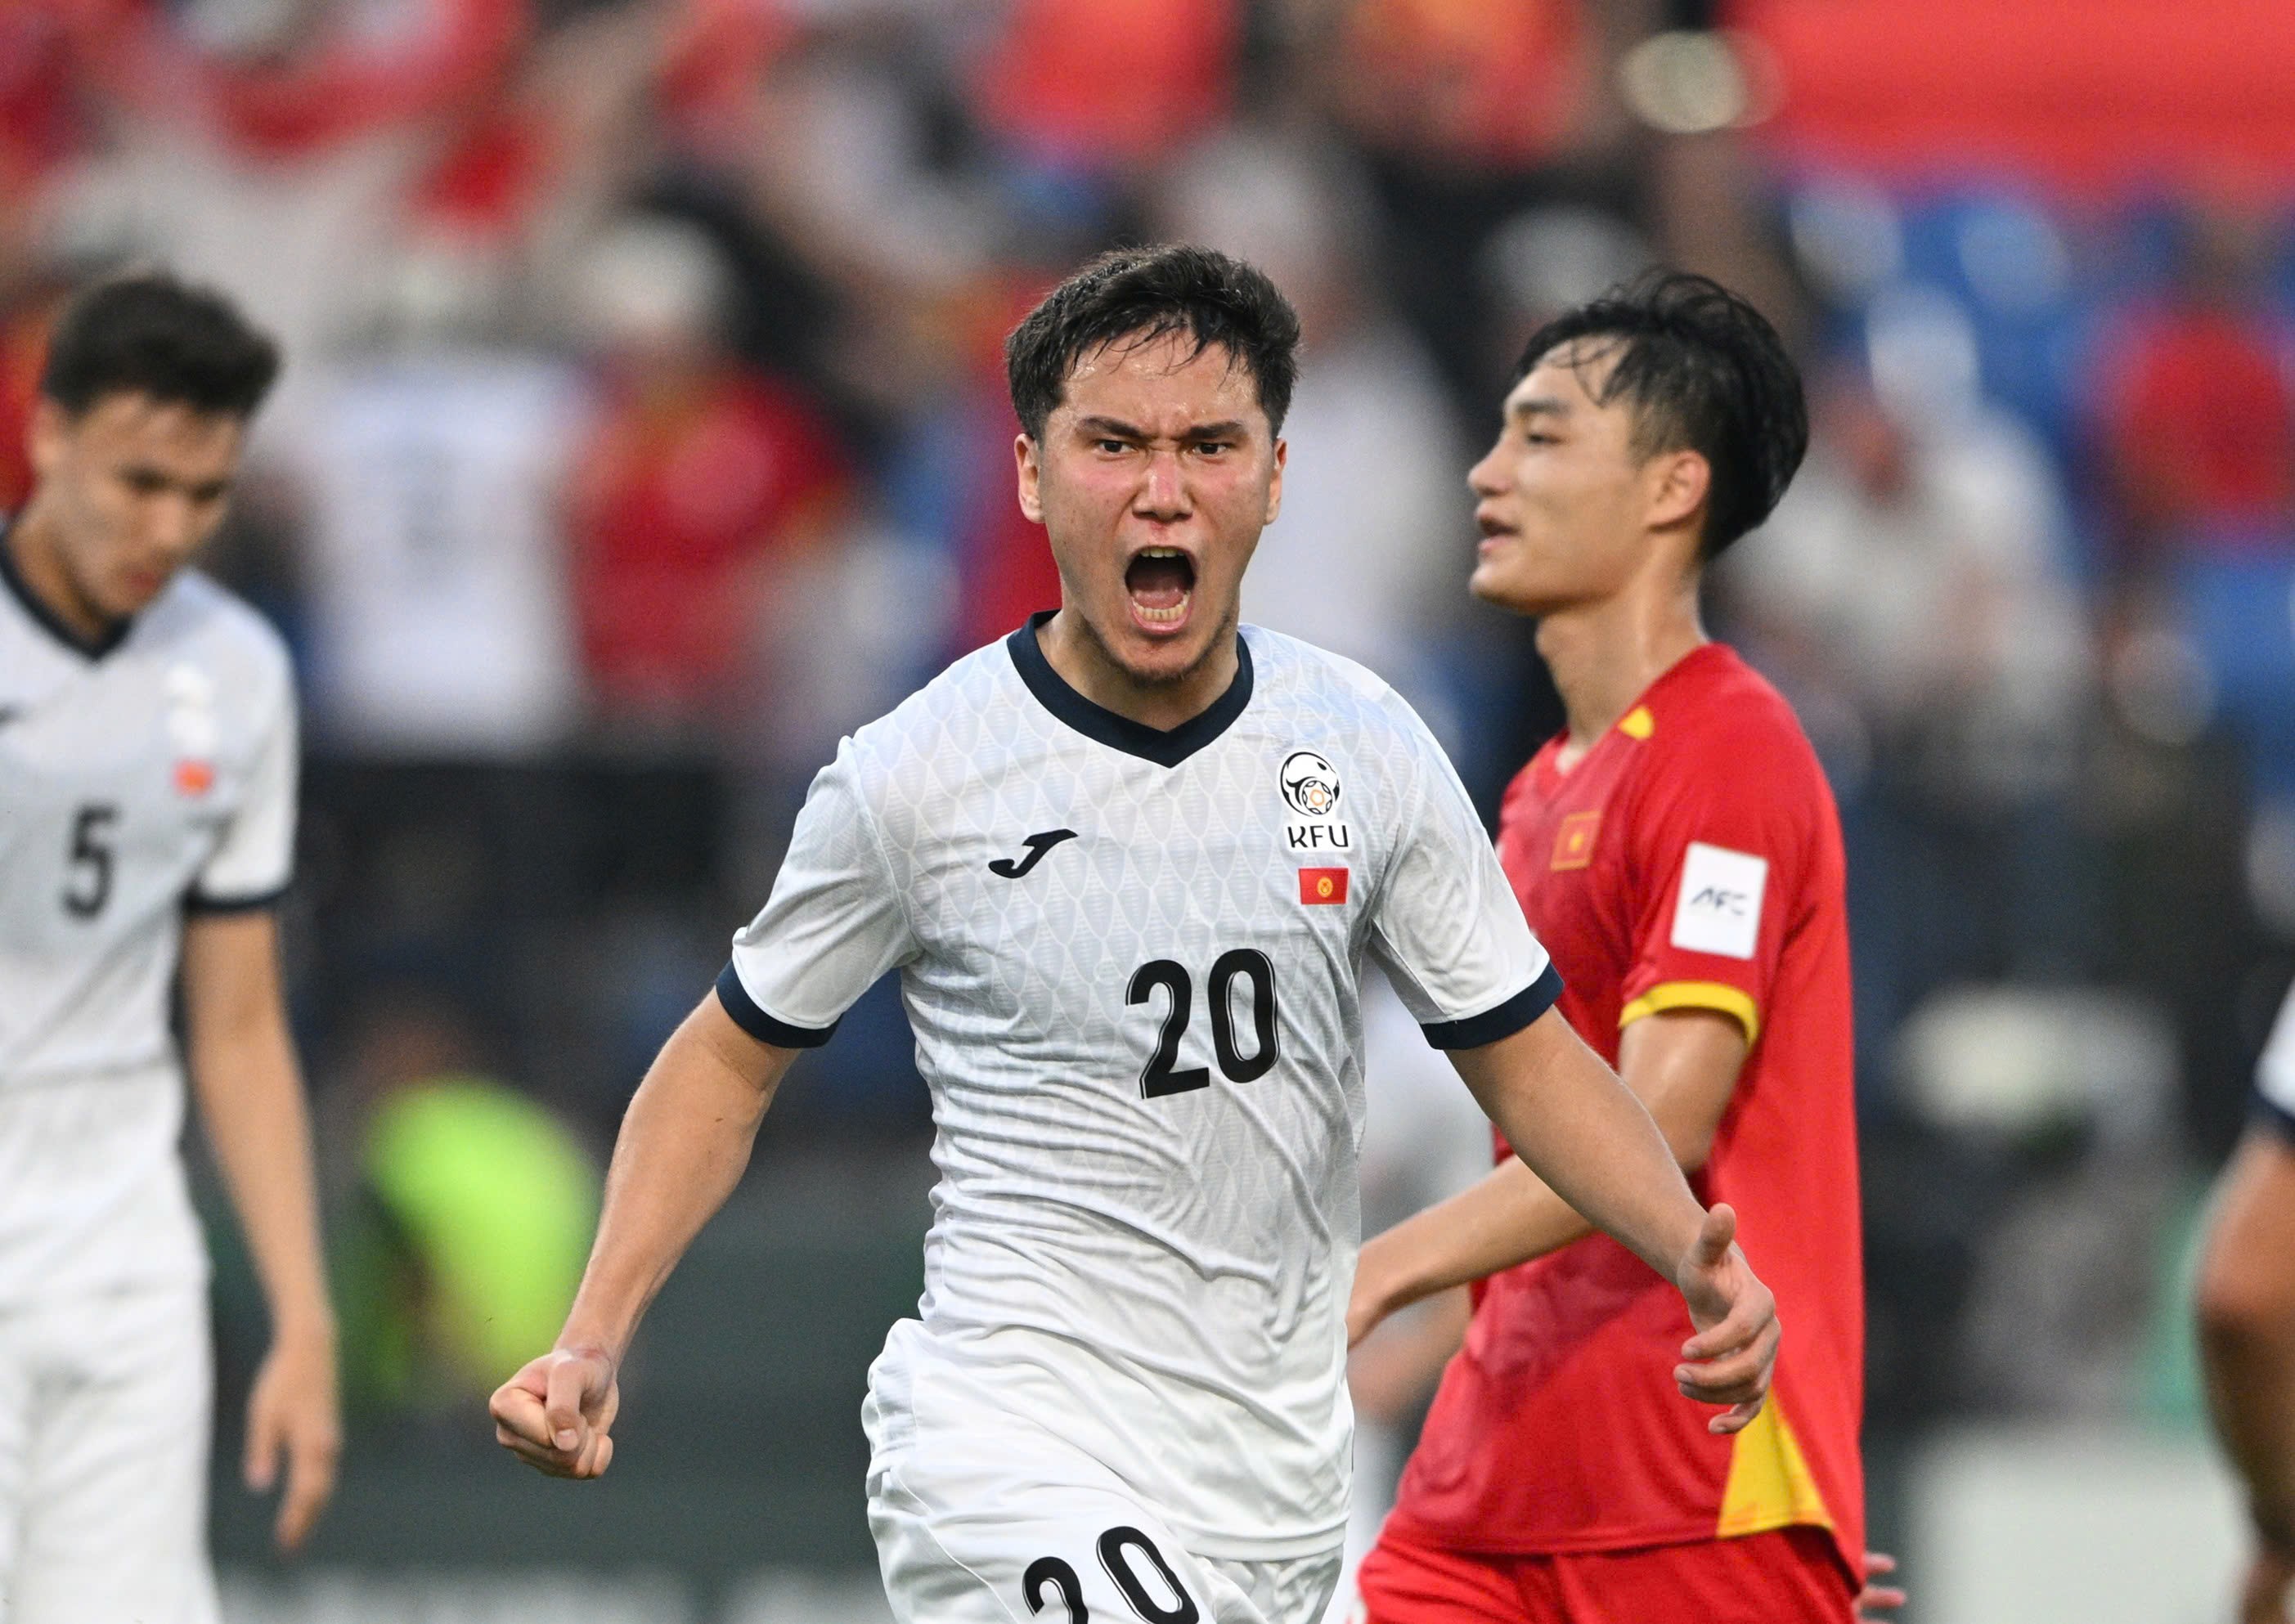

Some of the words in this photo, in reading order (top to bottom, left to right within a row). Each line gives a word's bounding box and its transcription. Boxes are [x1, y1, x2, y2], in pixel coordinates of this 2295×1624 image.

[61, 801, 121, 916] 5
[1287, 824, 1349, 848] KFU
[1691, 886, 1748, 916] AFC
[1125, 949, 1280, 1099] 20
